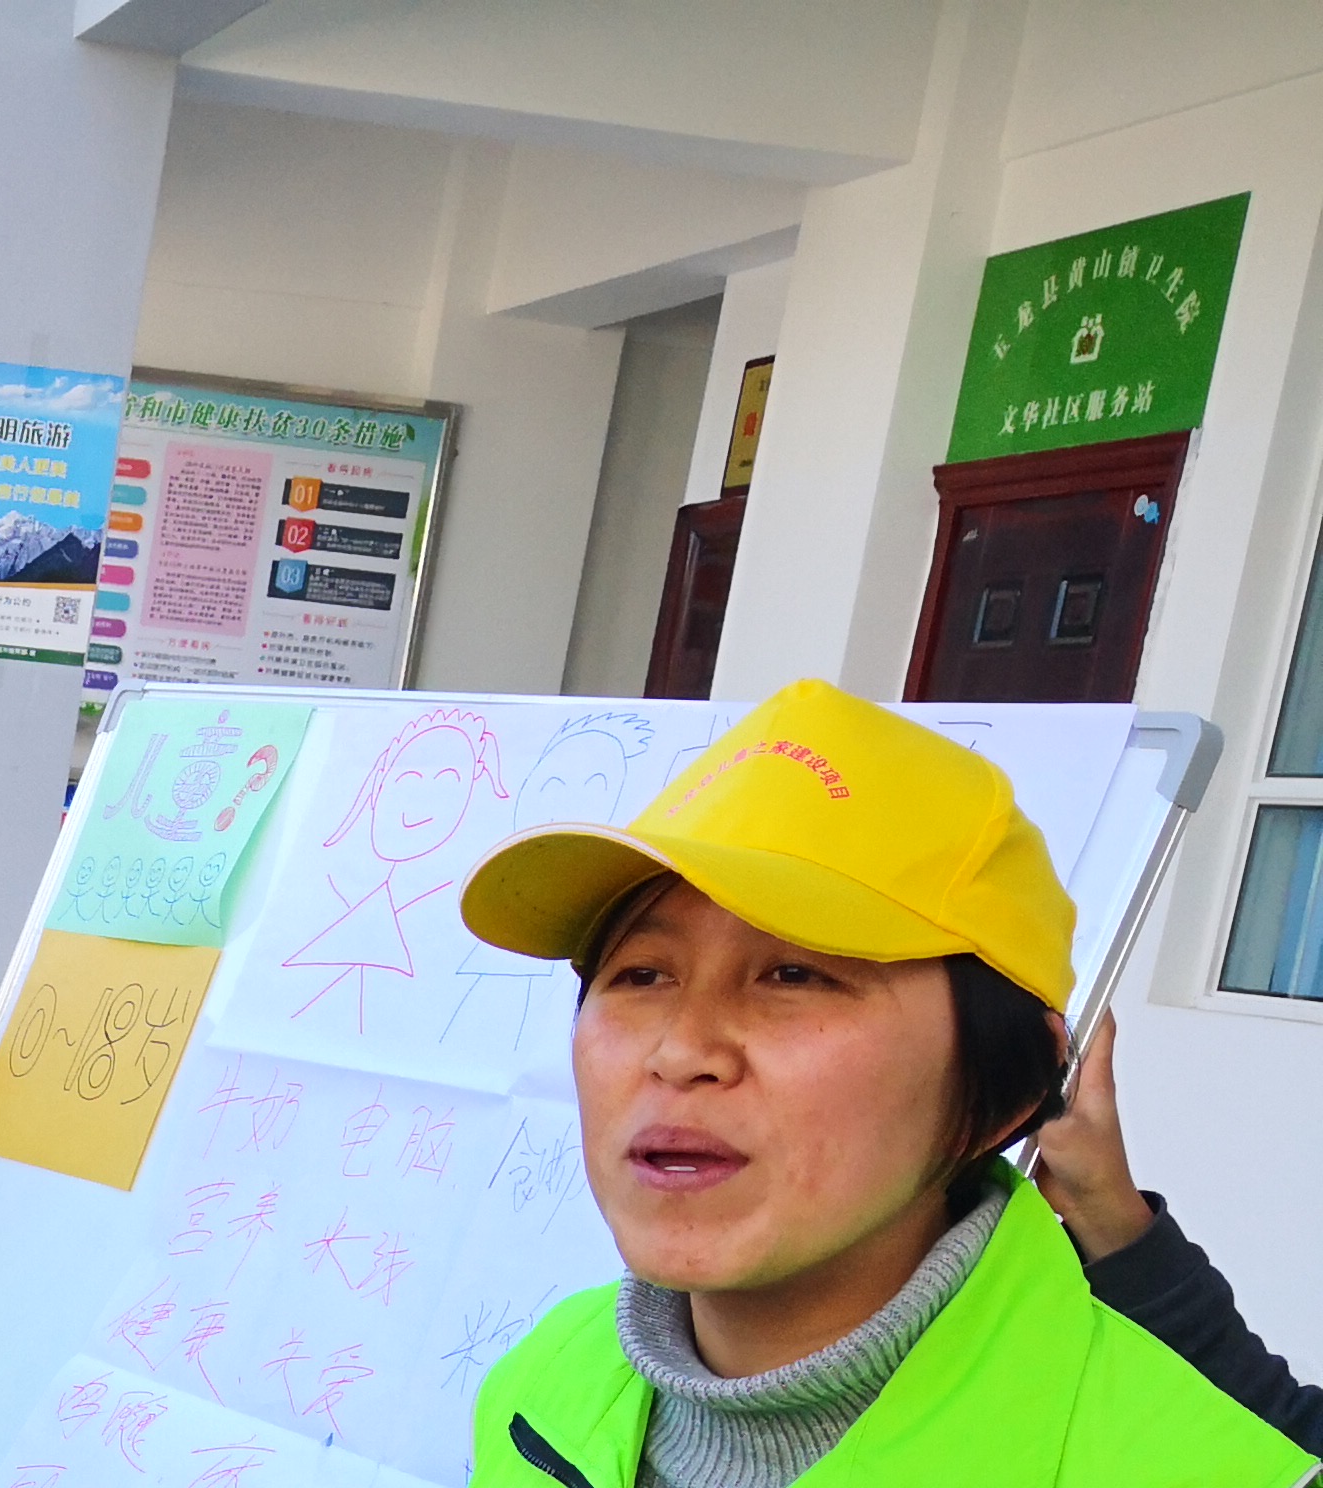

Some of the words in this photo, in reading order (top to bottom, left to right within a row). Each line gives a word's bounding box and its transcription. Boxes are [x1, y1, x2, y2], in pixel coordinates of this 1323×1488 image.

[998, 380, 1155, 435] 文华社区服务站
[294, 485, 313, 504] 01
[288, 525, 308, 545] 02
[280, 569, 300, 585] 03
[341, 1082, 456, 1183] 电脑
